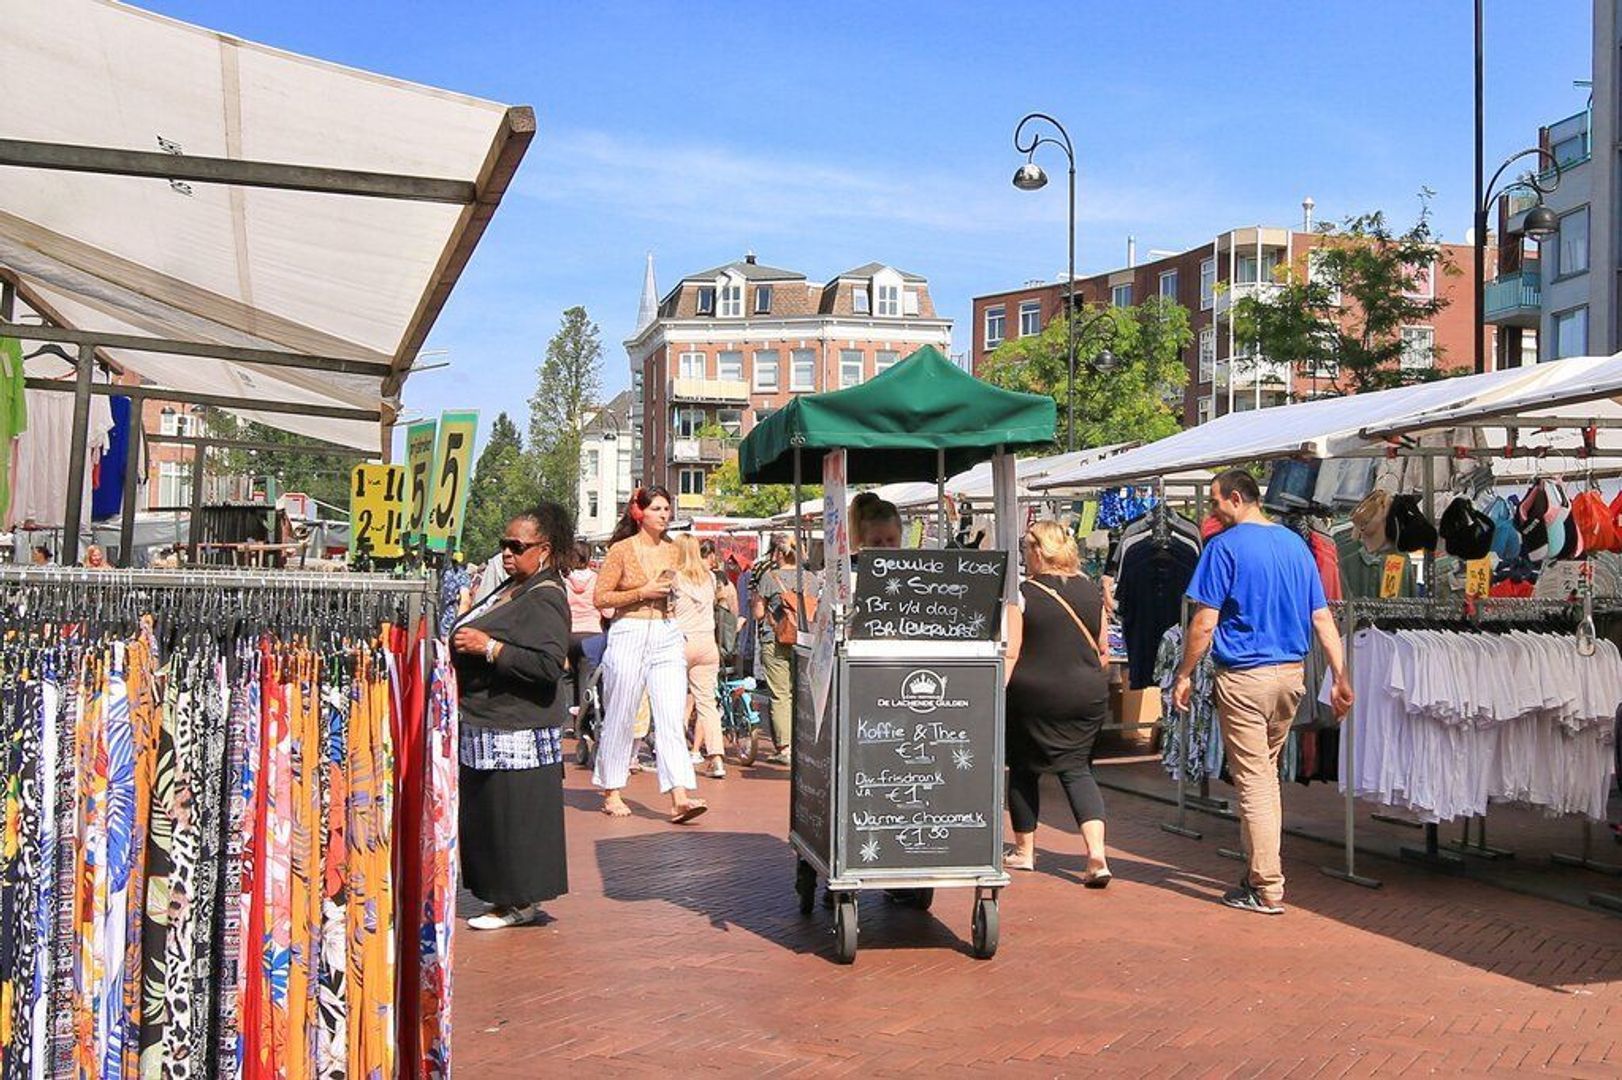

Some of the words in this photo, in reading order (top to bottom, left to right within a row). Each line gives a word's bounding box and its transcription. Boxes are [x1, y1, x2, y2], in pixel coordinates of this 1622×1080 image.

[907, 576, 969, 599] Snoep
[857, 717, 905, 740] Koffie
[914, 724, 927, 741] &
[928, 722, 967, 740] Thee
[852, 811, 907, 826] Warme
